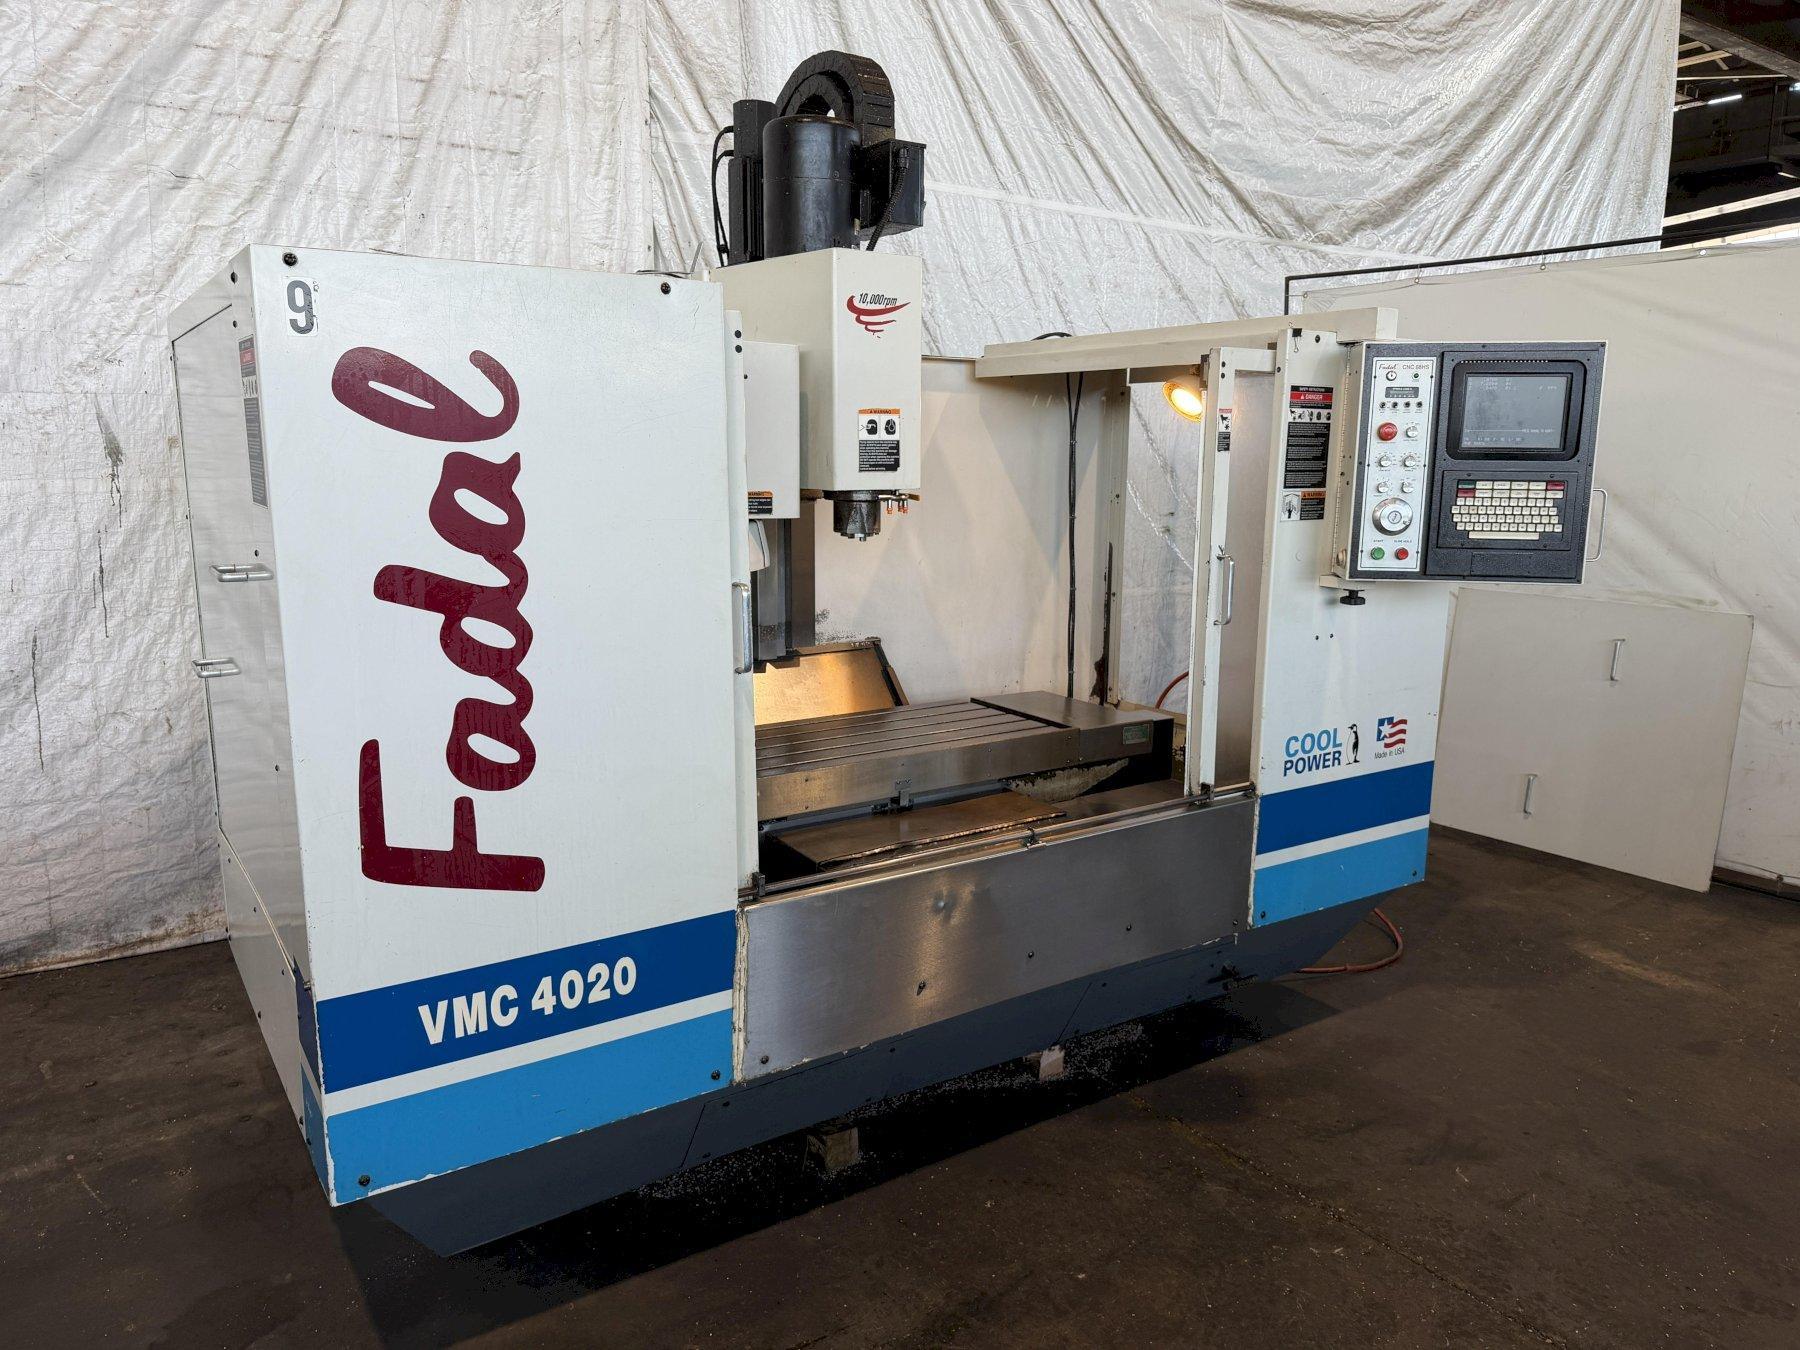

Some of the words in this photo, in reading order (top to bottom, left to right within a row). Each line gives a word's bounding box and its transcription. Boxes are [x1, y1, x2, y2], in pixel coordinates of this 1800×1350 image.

[287, 280, 314, 335] 9
[858, 292, 898, 307] 10,000rpm
[331, 346, 545, 892] Fadal
[1285, 728, 1342, 758] COOL
[1374, 752, 1388, 760] Made
[1394, 748, 1405, 756] USA
[1283, 750, 1342, 777] POWER
[418, 984, 519, 1045] VMC
[531, 956, 637, 1016] 4020
